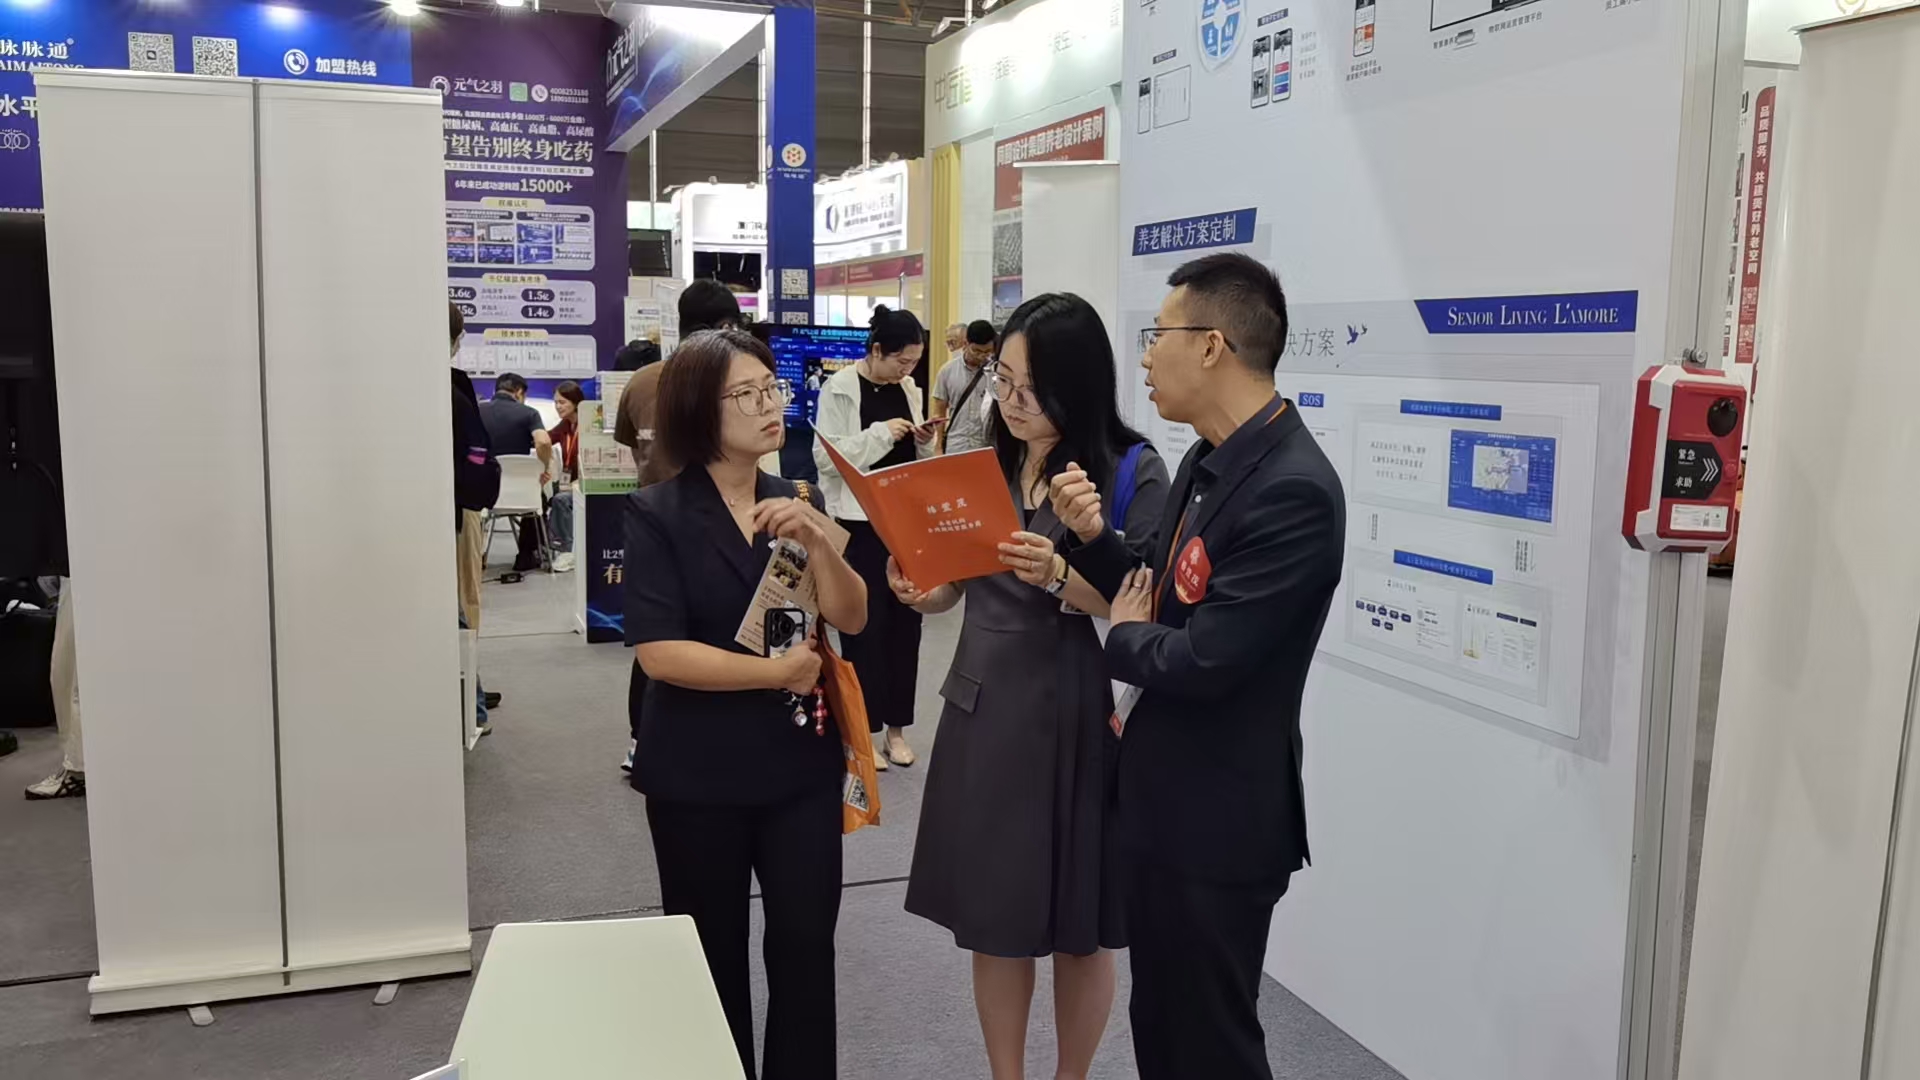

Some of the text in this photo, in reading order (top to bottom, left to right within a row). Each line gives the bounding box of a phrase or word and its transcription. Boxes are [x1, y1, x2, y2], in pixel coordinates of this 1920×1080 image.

[316, 57, 377, 77] 加盟热线
[453, 77, 503, 93] 元气之羽
[0, 93, 38, 119] 水平
[1138, 213, 1237, 252] 养老解决方案定制
[527, 290, 550, 301] 1.5亿
[527, 307, 550, 318] 1.4亿
[1302, 394, 1321, 406] SOS
[1675, 475, 1693, 489] 求助
[603, 562, 624, 585] 有
